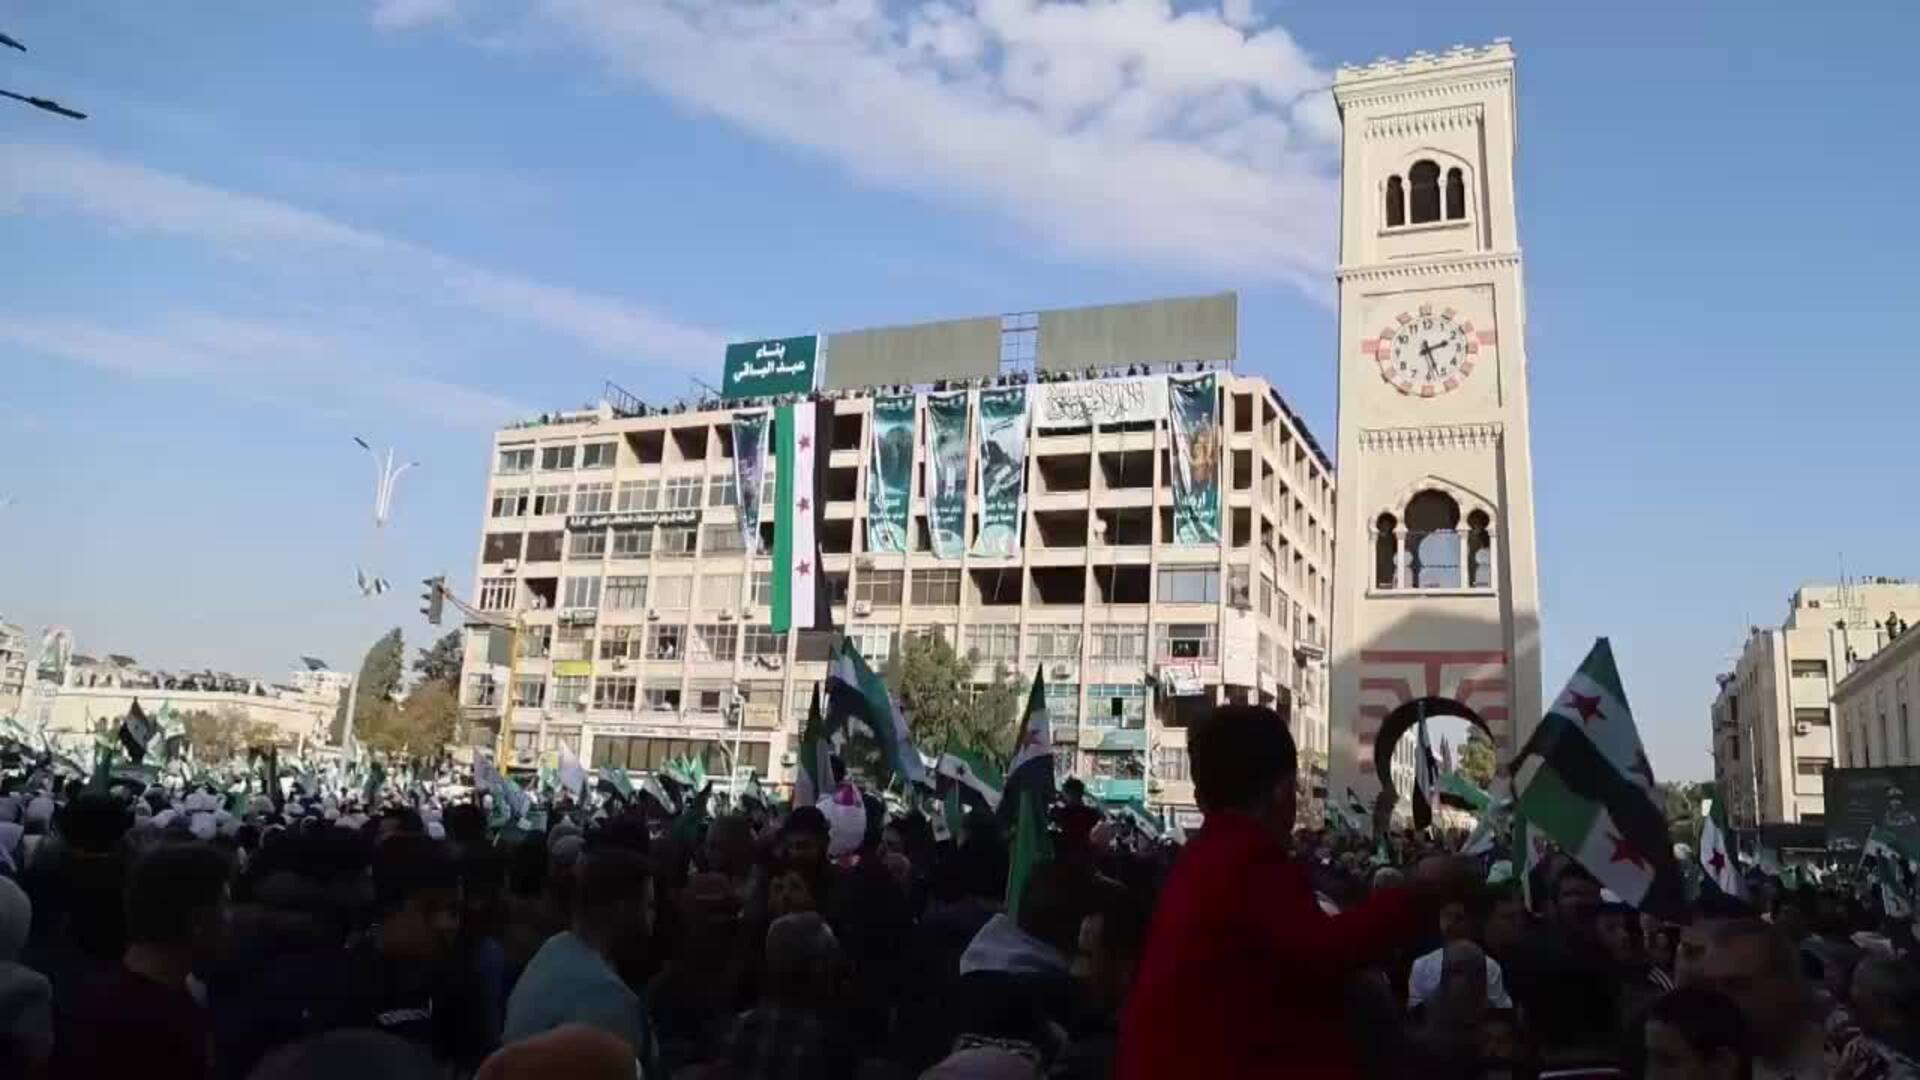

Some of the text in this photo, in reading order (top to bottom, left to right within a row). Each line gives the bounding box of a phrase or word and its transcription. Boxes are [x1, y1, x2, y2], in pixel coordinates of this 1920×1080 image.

[1409, 325, 1418, 334] 11
[1423, 320, 1433, 330] 12
[1450, 330, 1457, 340] 2
[756, 342, 786, 359] بناء
